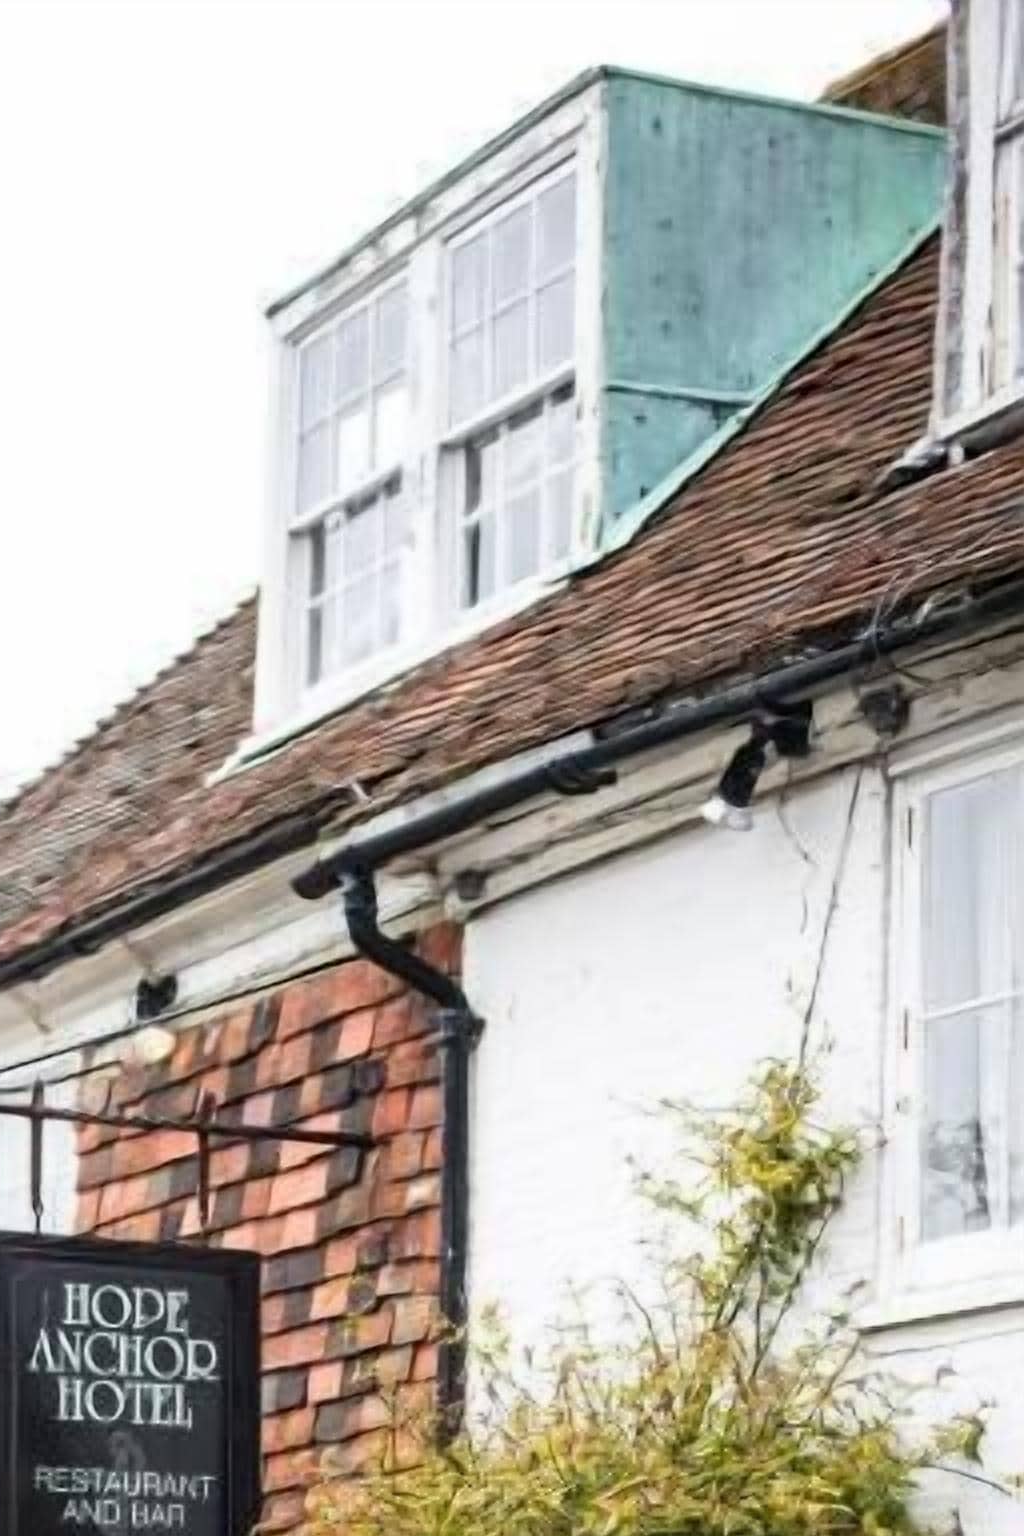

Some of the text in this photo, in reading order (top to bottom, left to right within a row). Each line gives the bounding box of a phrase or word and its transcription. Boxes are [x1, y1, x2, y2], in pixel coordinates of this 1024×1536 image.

[63, 1283, 189, 1333] HOPE
[29, 1327, 219, 1380] ANCHOR
[56, 1376, 192, 1429] HOTEL
[34, 1466, 216, 1502] RESTAURANT
[63, 1499, 185, 1528] AND BAR
